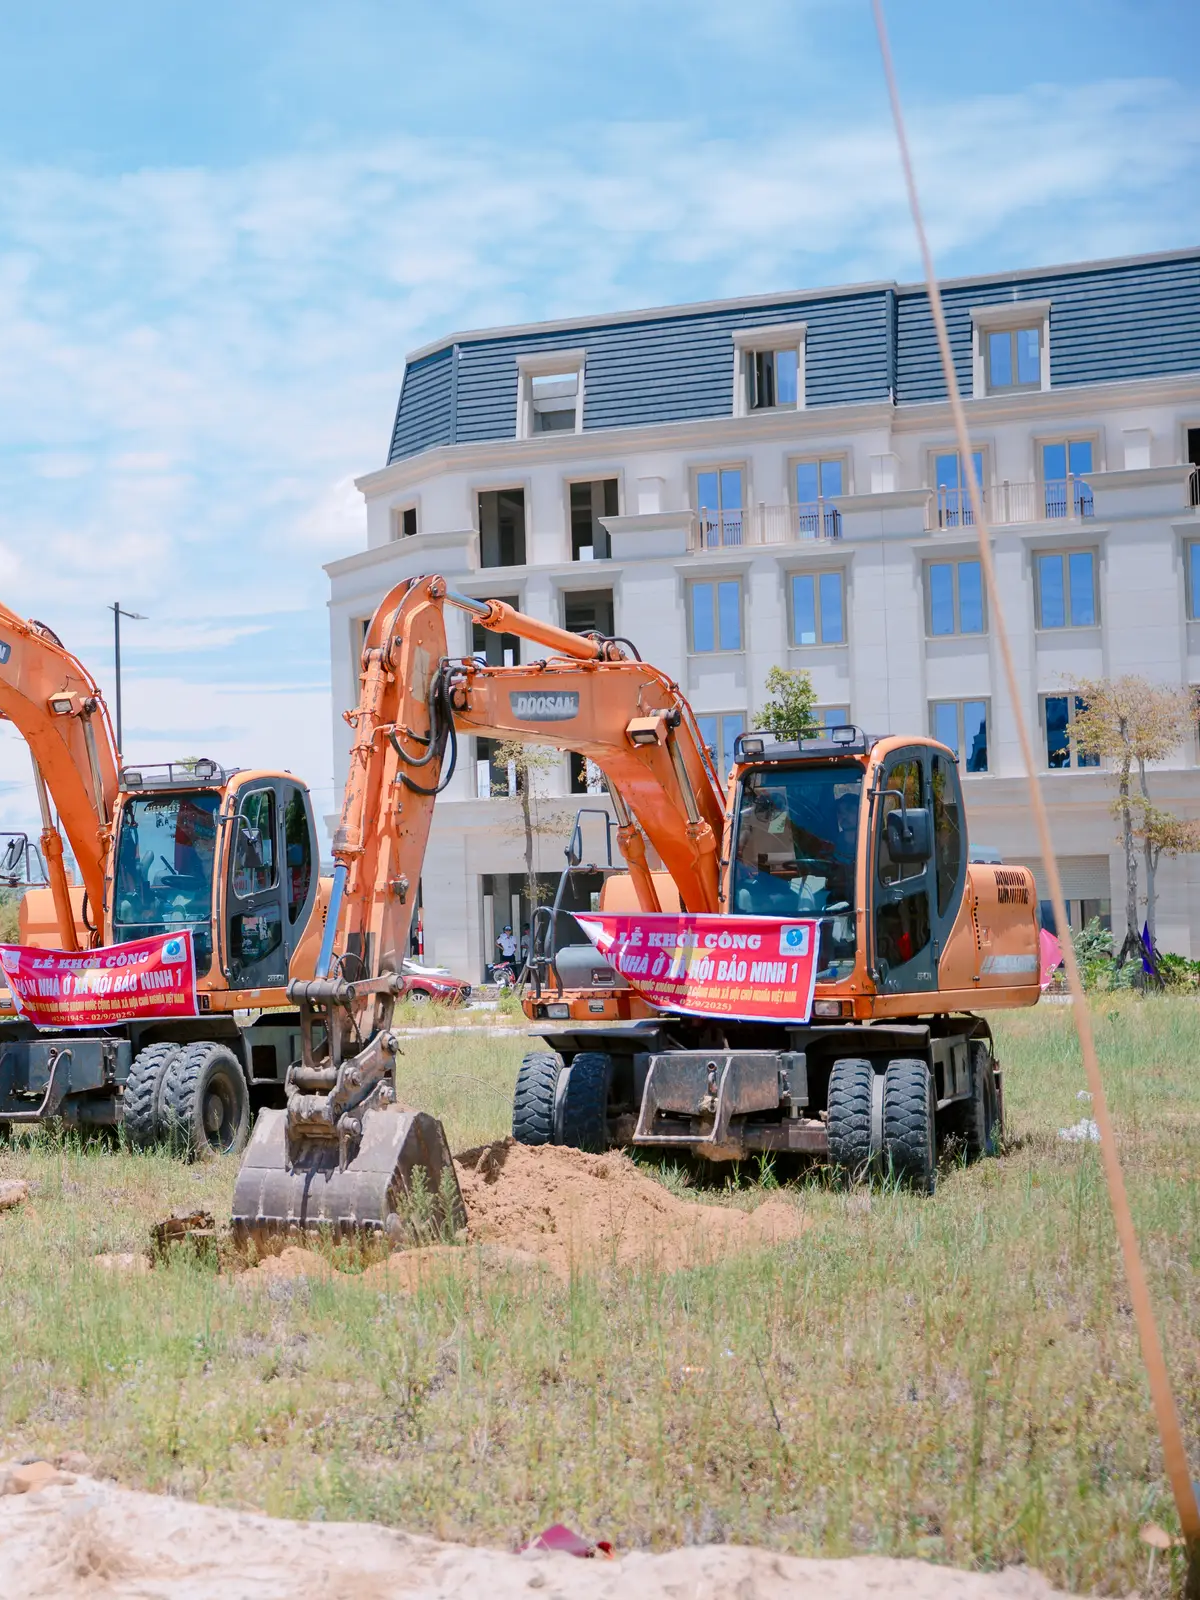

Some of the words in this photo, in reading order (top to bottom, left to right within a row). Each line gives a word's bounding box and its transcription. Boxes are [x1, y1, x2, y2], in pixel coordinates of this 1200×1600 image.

[517, 696, 575, 714] DOOSAN
[618, 926, 643, 946] LỄ
[647, 929, 699, 948] KHỞI
[704, 930, 762, 949] CÔNG
[32, 954, 55, 969] LỄ
[105, 951, 149, 968] CÔNG
[620, 952, 649, 974] NHÀ
[651, 951, 666, 976] Ở
[688, 955, 715, 984] HỘI
[716, 953, 748, 982] BẢO
[749, 961, 787, 983] NINH
[791, 962, 798, 983] 1
[38, 973, 60, 997] NHÀ
[62, 971, 72, 996] Ở
[91, 973, 113, 997] HỘI
[113, 969, 138, 993] BẢO
[140, 968, 174, 990] NINH
[175, 968, 182, 987] 1
